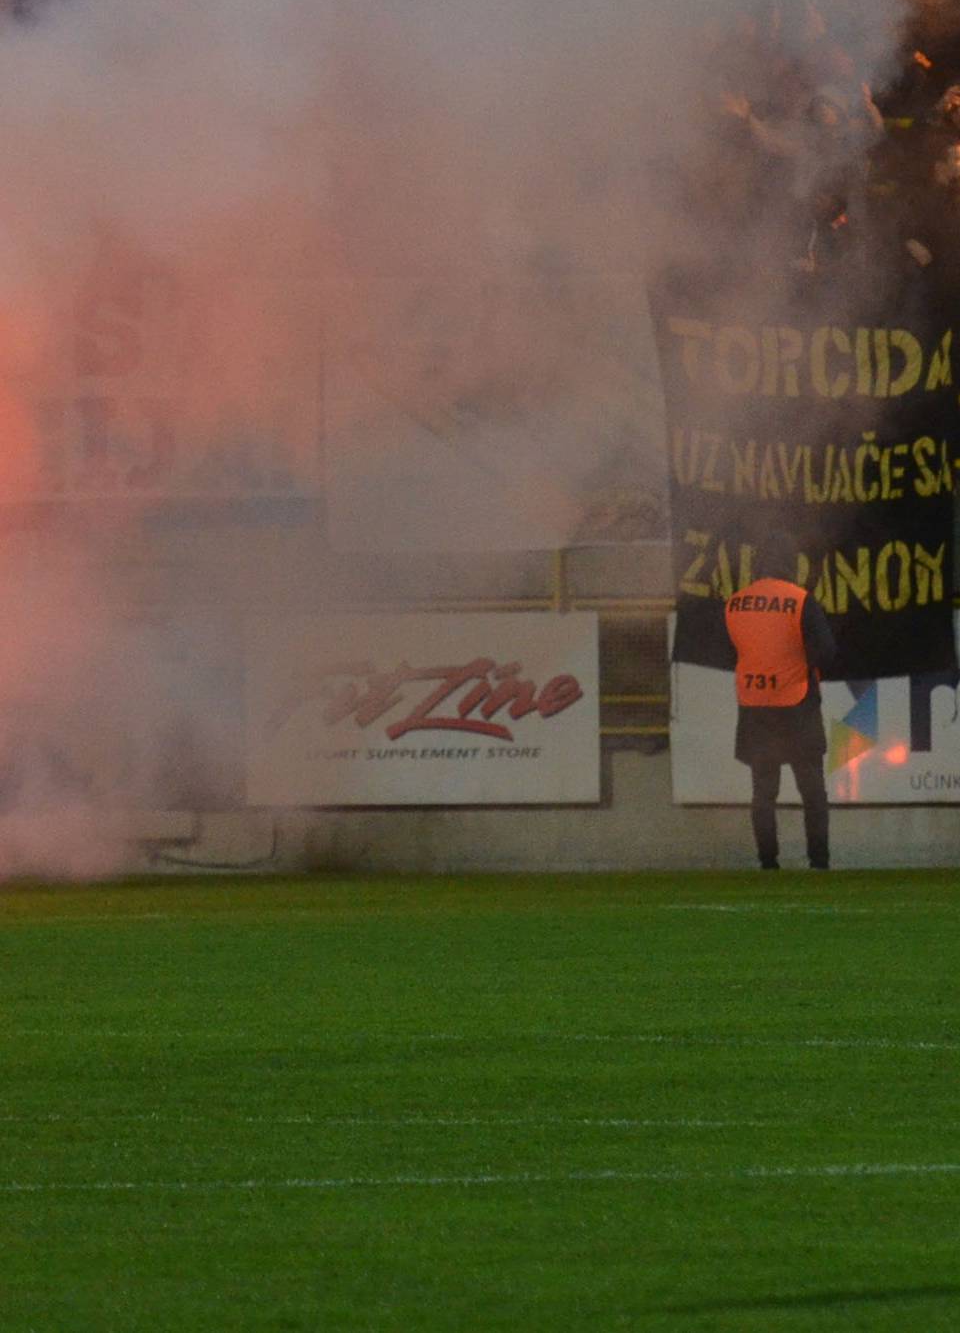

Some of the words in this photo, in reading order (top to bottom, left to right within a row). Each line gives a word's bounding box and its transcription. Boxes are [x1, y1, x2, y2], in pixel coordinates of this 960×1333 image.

[668, 318, 953, 399] TORCIDA
[728, 594, 797, 613] REDAR
[744, 672, 778, 689] 731
[365, 746, 480, 761] SUPPLEMENT
[487, 745, 542, 760] STORE
